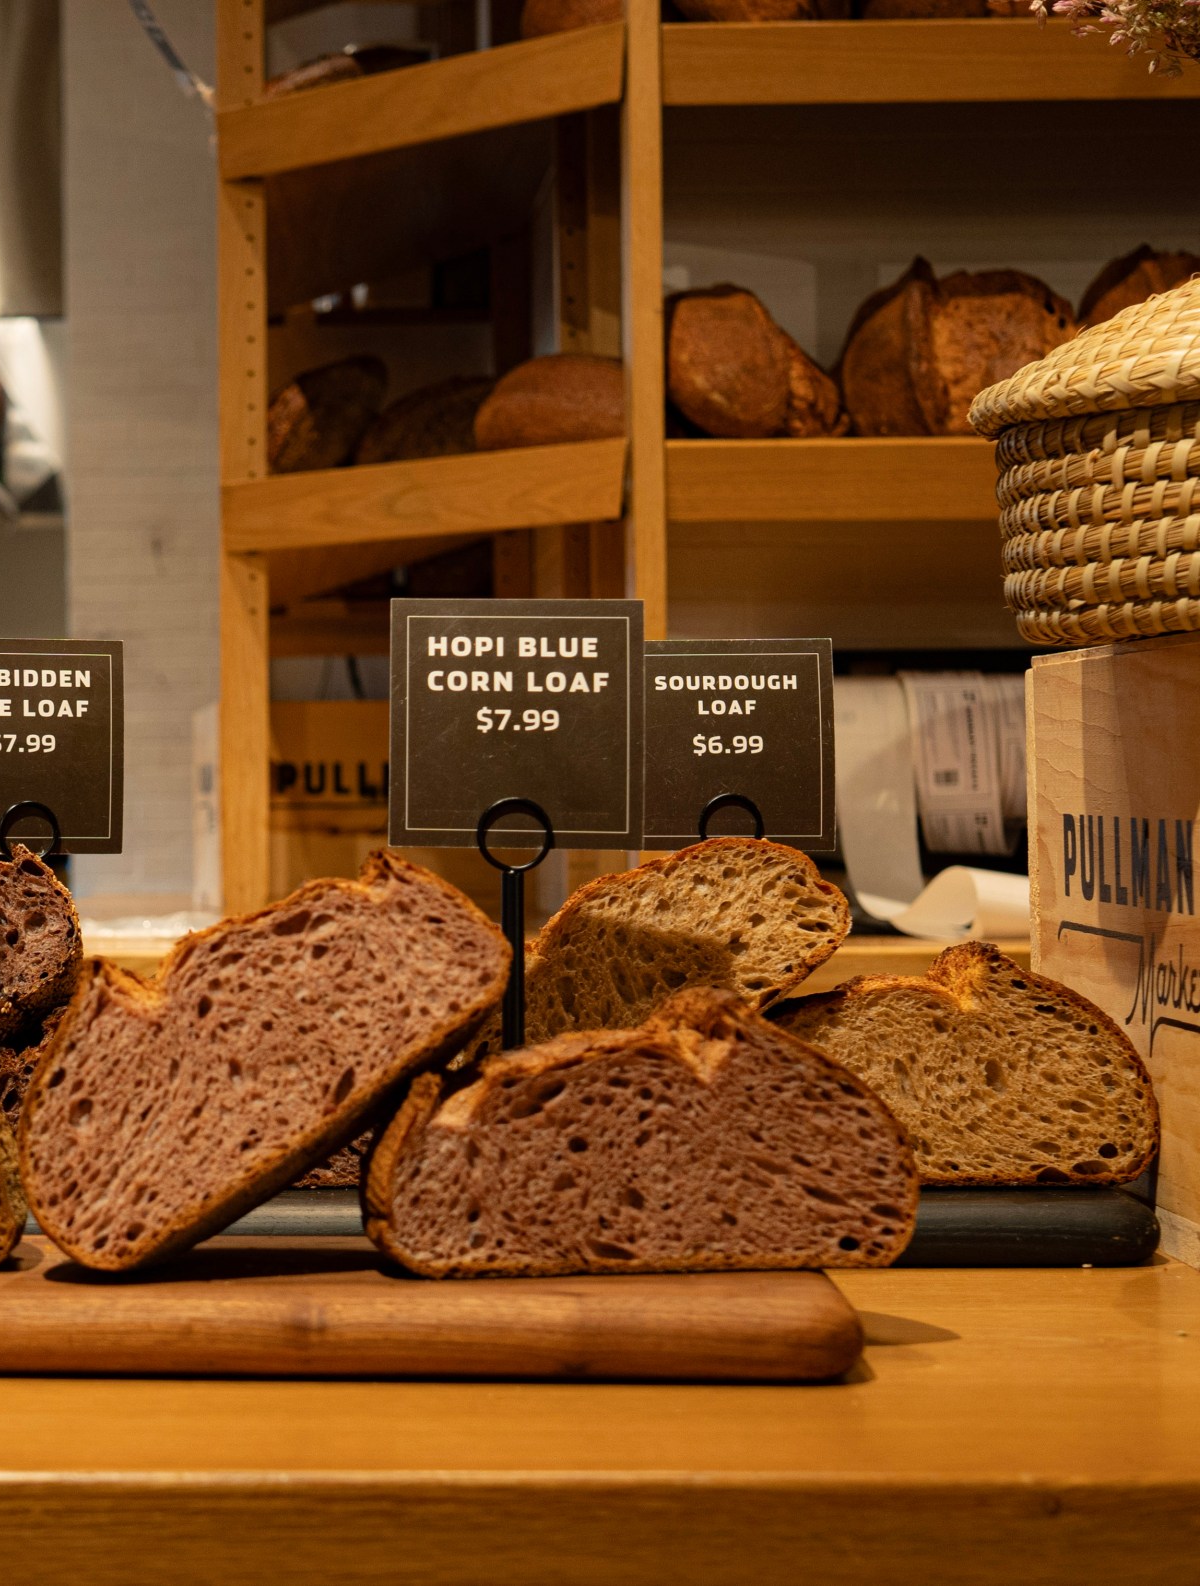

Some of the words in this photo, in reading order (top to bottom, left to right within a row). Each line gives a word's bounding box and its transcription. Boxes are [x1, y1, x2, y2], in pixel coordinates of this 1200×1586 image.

[427, 635, 505, 658] HOPI
[518, 636, 599, 659] BLUE
[426, 670, 514, 693] CORN
[526, 671, 610, 694] LOAF
[654, 674, 799, 692] SOURDOUGH
[22, 699, 89, 718] LOAF
[476, 705, 560, 734] $7.99
[697, 699, 757, 717] LOAF
[692, 733, 764, 757] $6.99
[1062, 813, 1195, 916] PULLMAN
